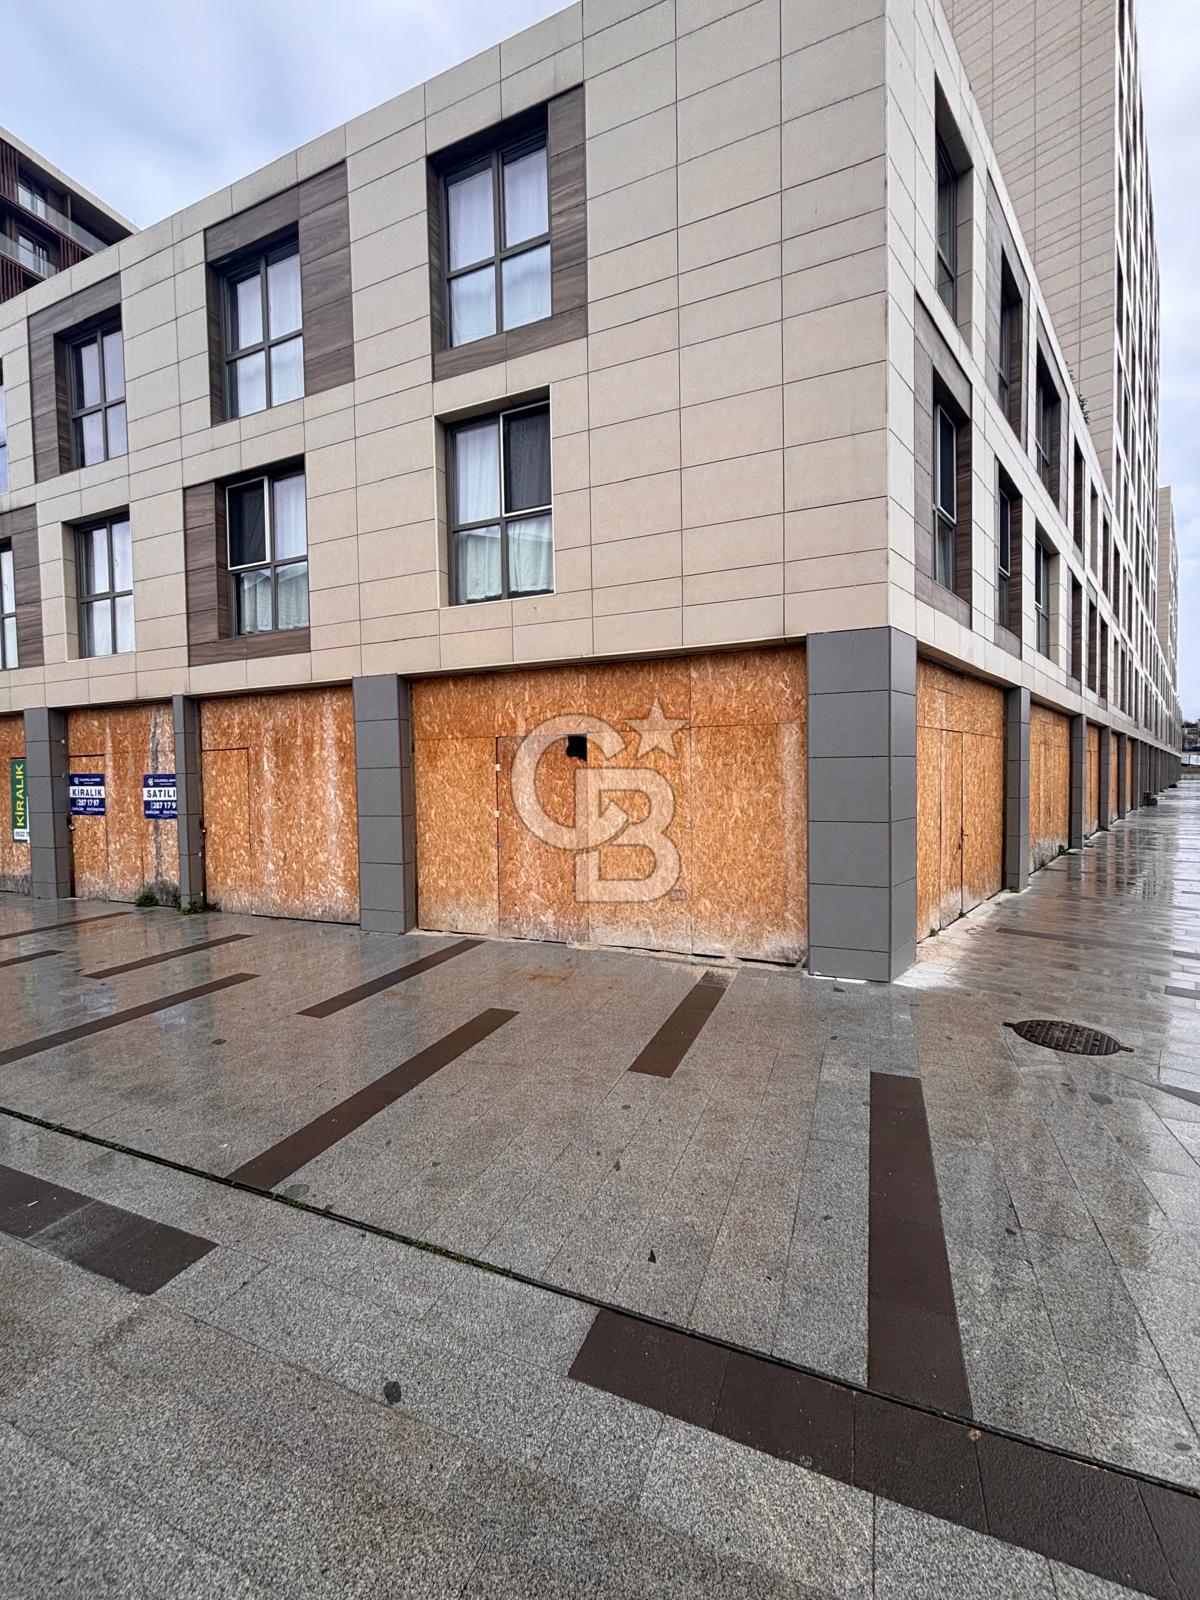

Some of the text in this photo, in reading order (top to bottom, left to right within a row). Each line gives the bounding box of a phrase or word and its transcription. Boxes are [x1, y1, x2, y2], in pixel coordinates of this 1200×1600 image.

[15, 764, 24, 826] KİRALIK
[72, 787, 103, 797] KİRALIK
[146, 789, 176, 798] SATILI
